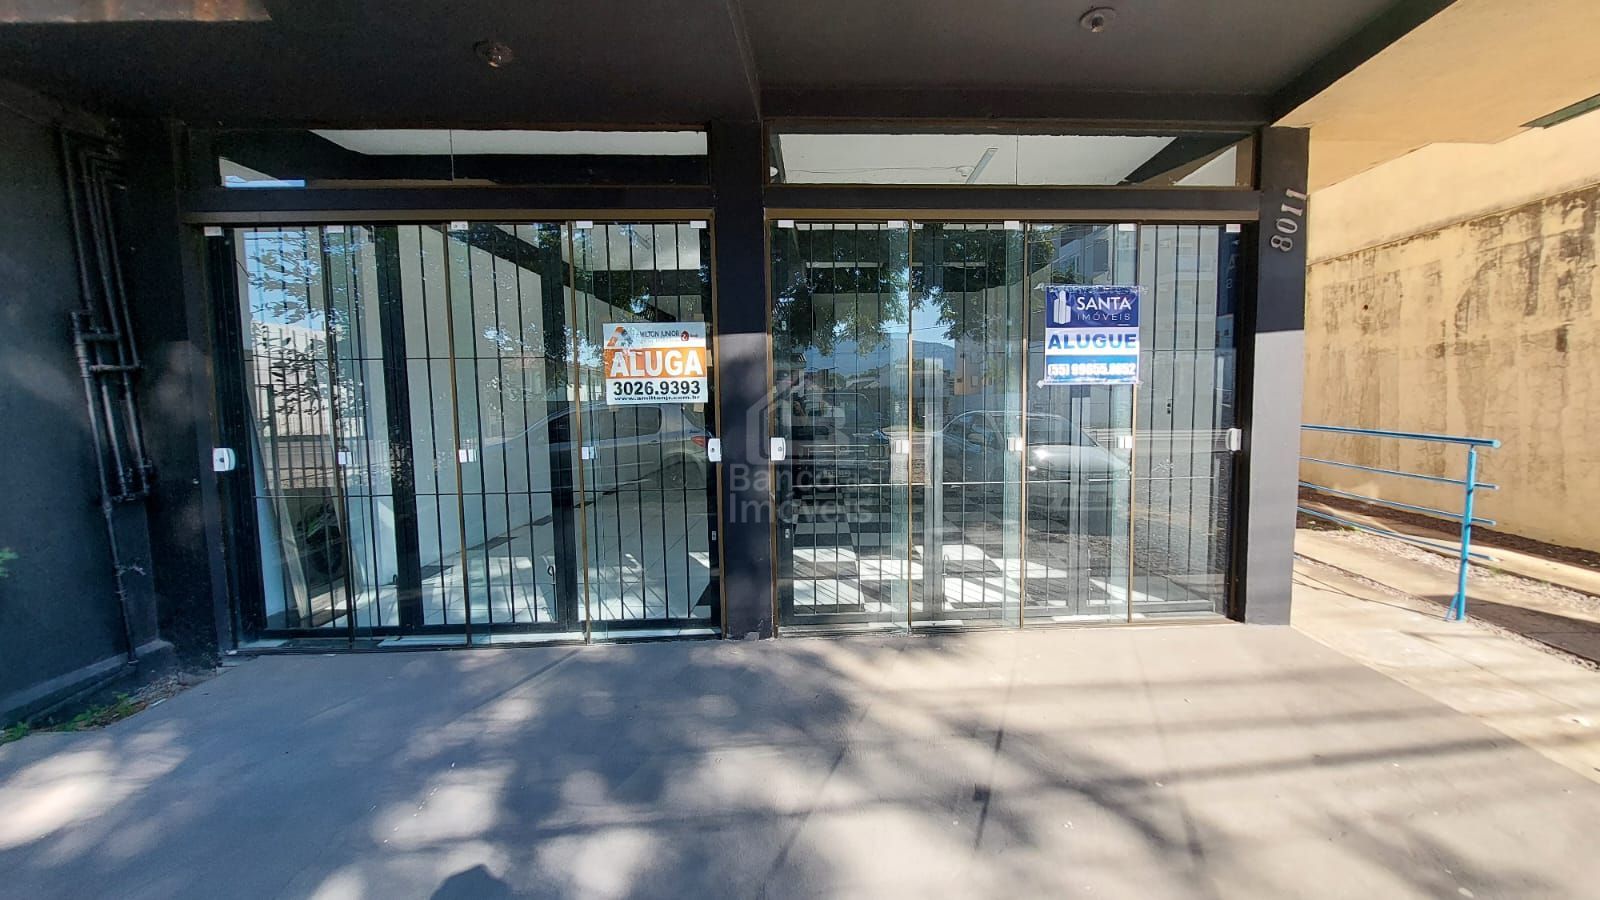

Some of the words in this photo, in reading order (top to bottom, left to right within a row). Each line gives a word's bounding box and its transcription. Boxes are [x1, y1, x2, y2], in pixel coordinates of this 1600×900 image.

[1076, 296, 1132, 310] SANTA
[1077, 311, 1131, 321] IMÓVEIS
[1048, 333, 1136, 349] ALUGUE
[610, 350, 703, 376] ALUGA
[613, 380, 700, 396] 3026.9393
